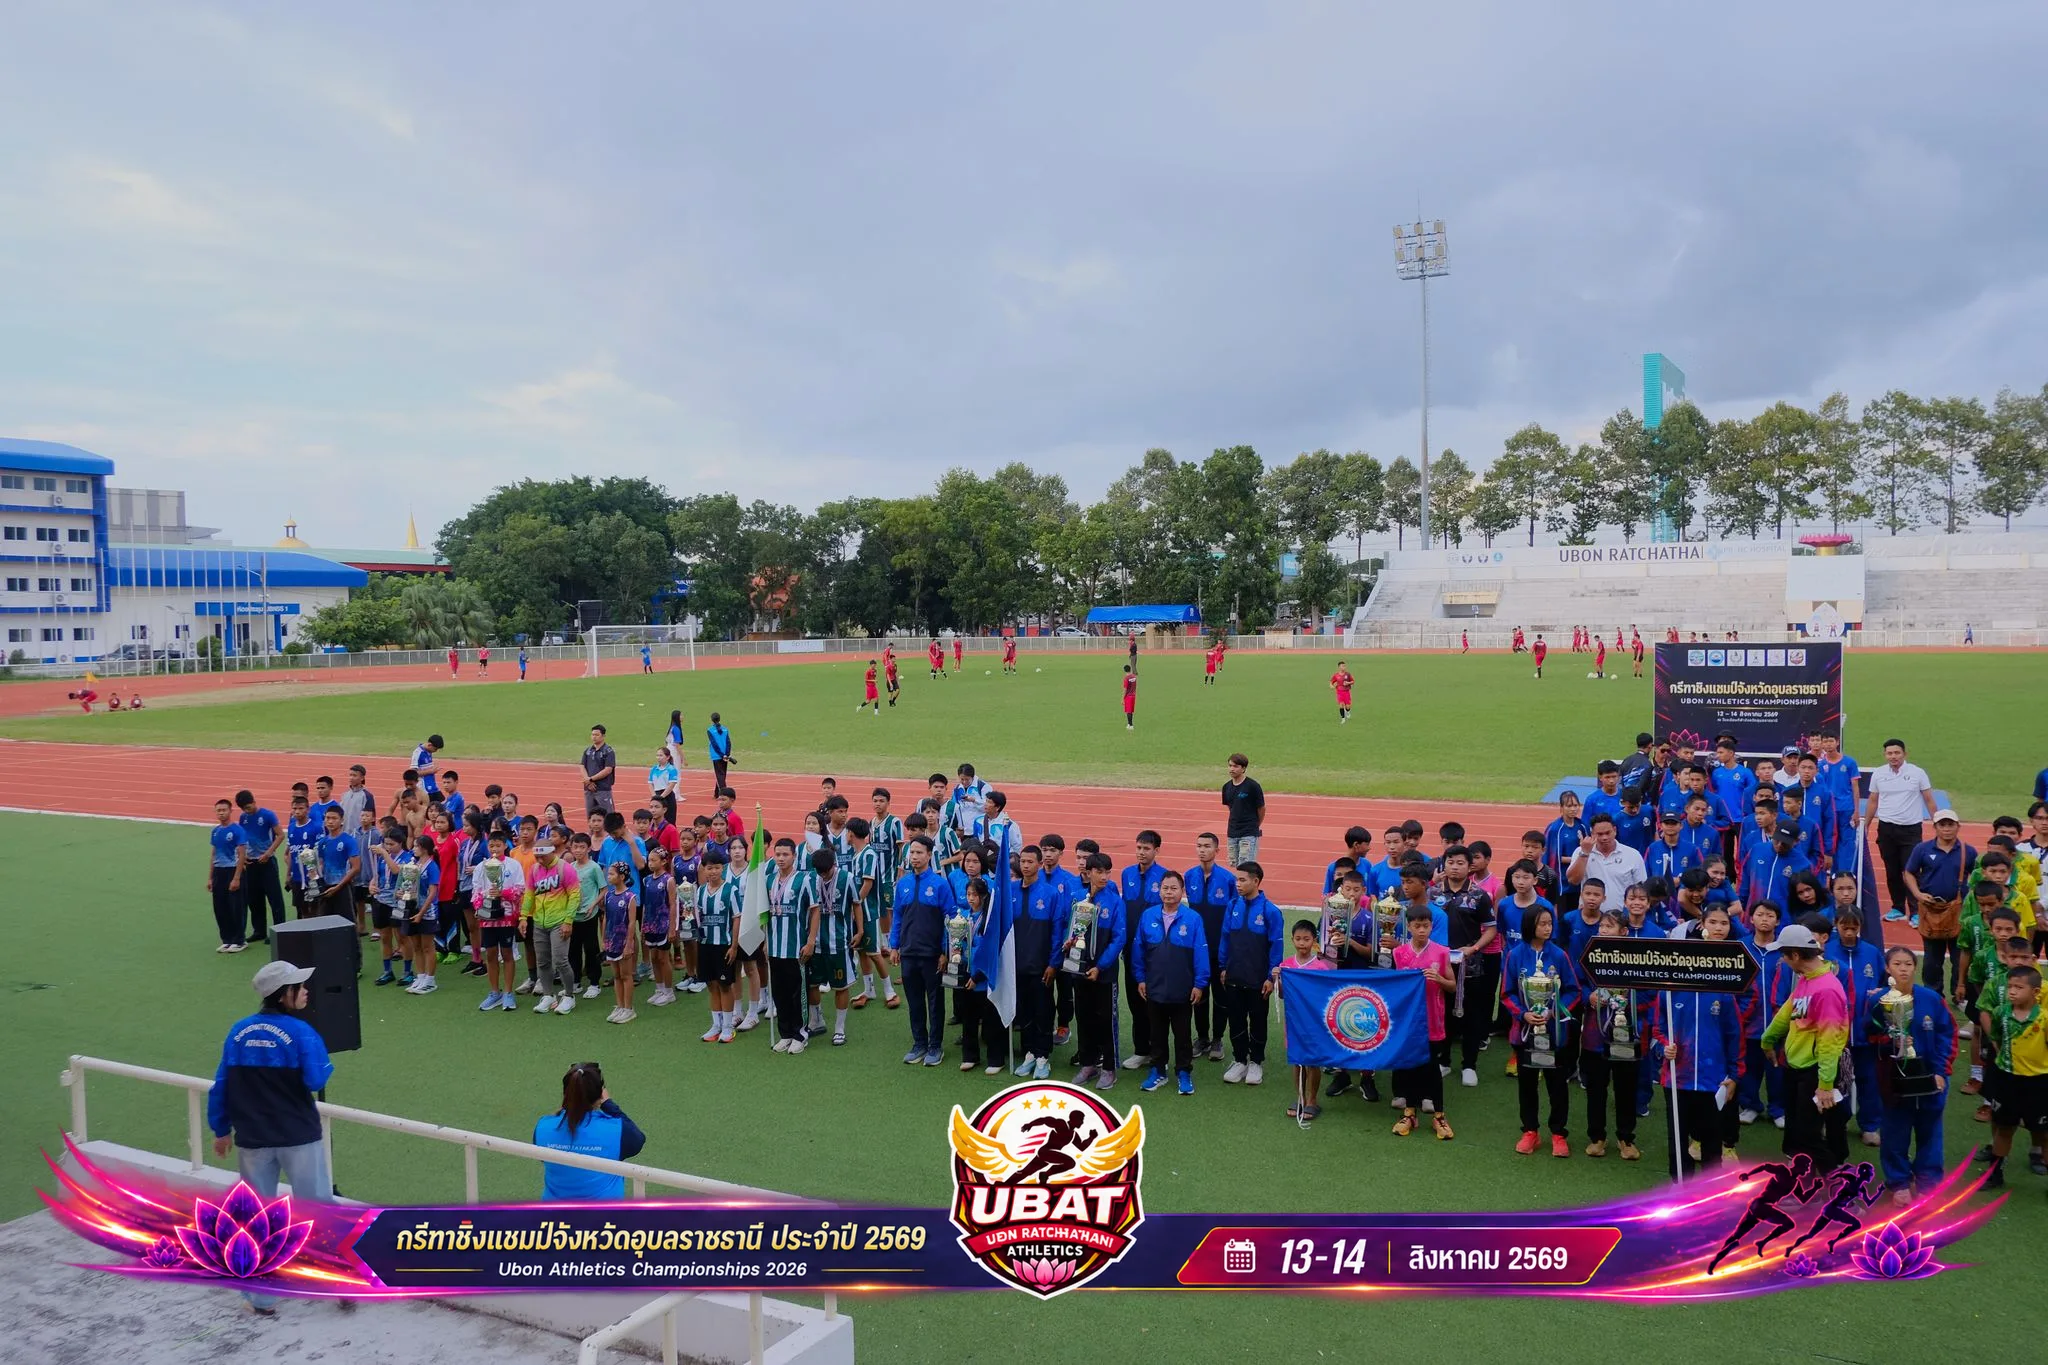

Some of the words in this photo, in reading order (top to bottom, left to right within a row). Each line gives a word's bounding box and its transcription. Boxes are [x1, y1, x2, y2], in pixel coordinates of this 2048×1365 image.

[1559, 548, 1603, 563] UBON
[1609, 546, 1703, 561] RATCHATHA
[1669, 681, 1828, 699] กรีฑาชิงแชมป์จังหวัดอุบลราชธานี
[1680, 697, 1704, 705] UBON
[1706, 697, 1750, 705] ATHLETICS
[1753, 698, 1818, 706] CHAMPIONSHIPS
[1588, 949, 1745, 971] กรีฑาชิงแชมป์จังหวัดอุบลราชธานี
[833, 968, 844, 980] 10
[1595, 968, 1620, 976] UBON
[1623, 970, 1669, 978] ATHLETICS
[1672, 972, 1742, 982] CHAMPIONSHIPS
